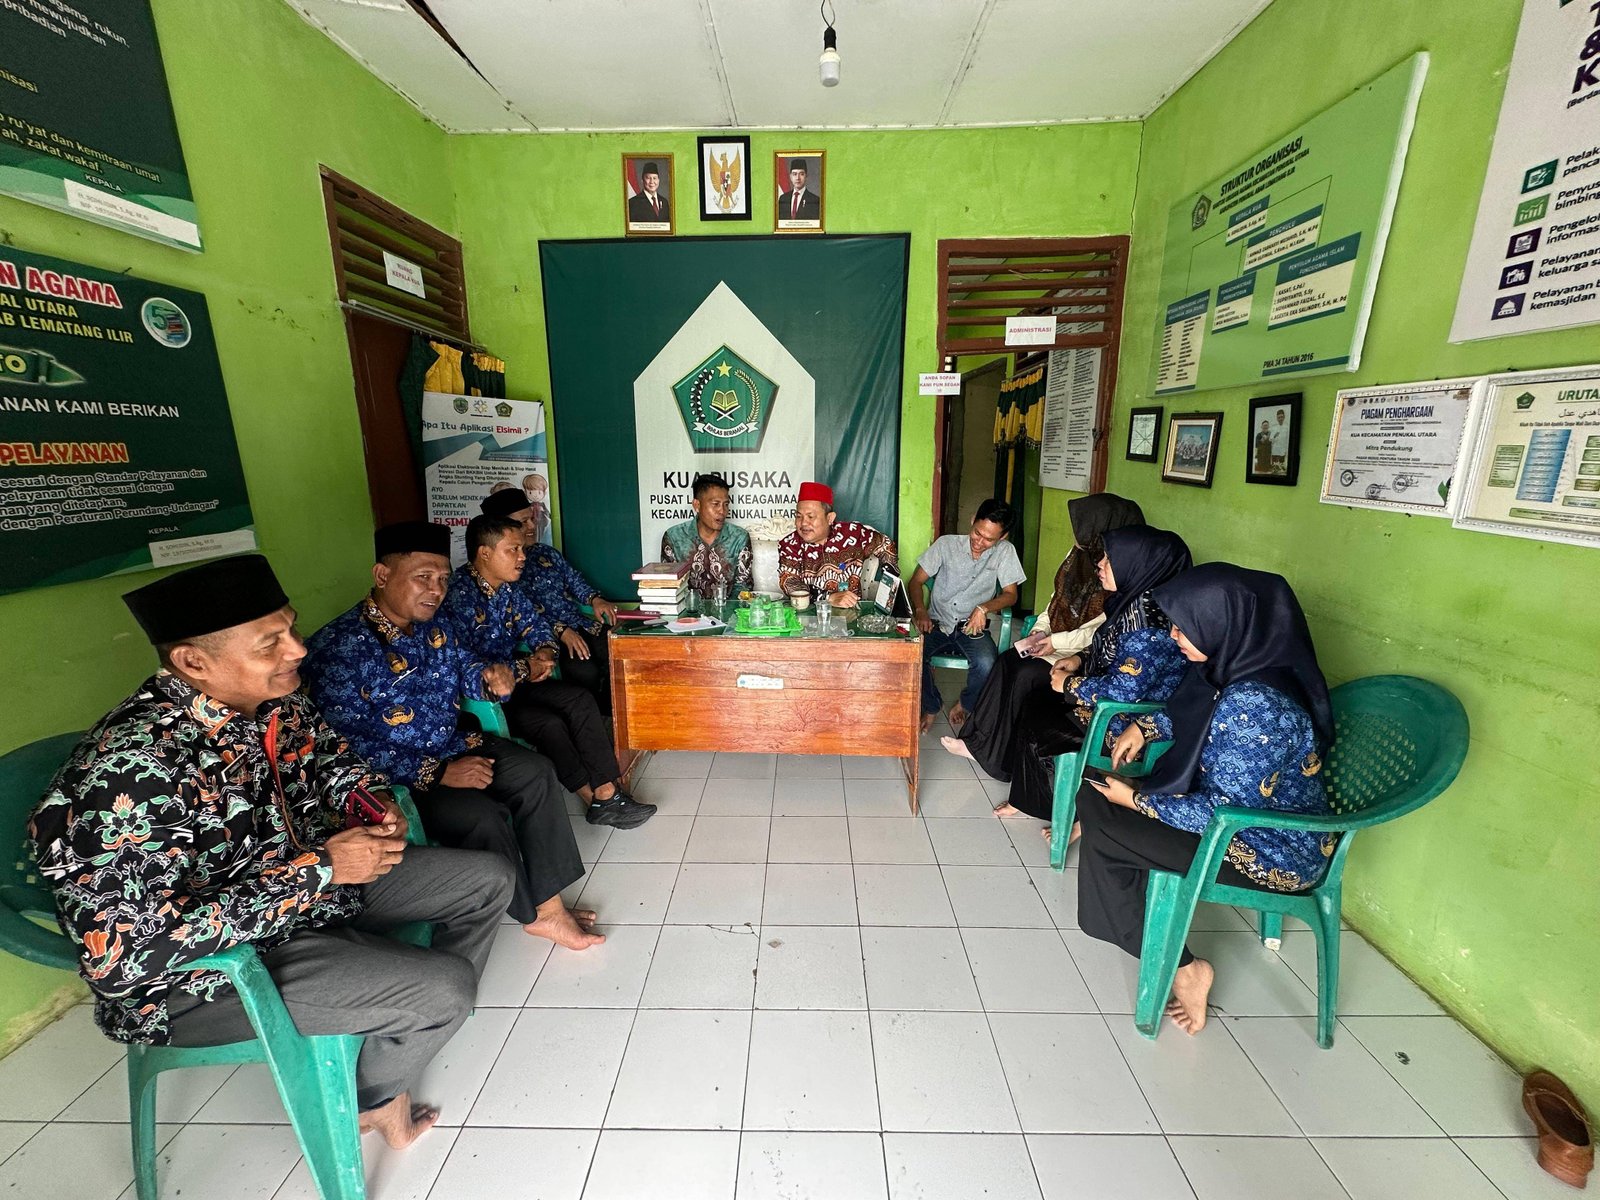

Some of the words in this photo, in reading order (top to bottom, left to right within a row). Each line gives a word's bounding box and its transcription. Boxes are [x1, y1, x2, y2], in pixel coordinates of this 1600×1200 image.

[0, 0, 66, 37] pribadian
[27, 137, 61, 158] zakat
[50, 132, 75, 149] dan
[77, 142, 133, 172] kemitraan
[134, 165, 162, 183] umat
[1220, 166, 1255, 197] STRUKTUR
[1255, 135, 1303, 175] ORGANISASI
[1329, 245, 1346, 256] ISLAM
[1538, 261, 1589, 278] keluarga
[26, 266, 123, 309] AGAMA
[1533, 282, 1593, 300] Pelayanan
[25, 297, 78, 318] UTARA
[1530, 293, 1596, 310] kemasjidan
[0, 312, 15, 326] B
[20, 314, 102, 339] LEMATANG
[107, 330, 134, 343] ILIR
[1281, 355, 1300, 365] TAHUN
[1299, 352, 1315, 362] 2016
[1557, 388, 1600, 401] URUTA
[55, 399, 104, 415] KAMI
[108, 402, 180, 418] BERIKAN
[1361, 408, 1385, 420] PIAGAM
[1384, 405, 1434, 419] PENGHARGAAN
[441, 421, 457, 430] Itu
[460, 423, 494, 433] Aplikasi
[0, 442, 129, 466] PELAYANAN
[0, 474, 46, 488] sesuai
[48, 474, 94, 486] dengan
[95, 472, 138, 483] Standar
[140, 470, 189, 481] Pelayanan
[190, 469, 207, 477] dan
[0, 490, 67, 504] pelayanan
[67, 486, 99, 497] tidak
[100, 483, 136, 495] sesuai
[137, 482, 174, 493] dengan
[650, 494, 684, 505] PUSAT
[737, 494, 797, 504] KEAGAMAA
[27, 503, 61, 516] yang
[62, 498, 127, 511] ditetapkan,
[651, 509, 695, 519] KECAMA
[726, 509, 767, 519] ENUKAL
[770, 509, 797, 519] UTAR
[1, 517, 53, 530] dengan
[54, 511, 112, 525] Peraturan
[433, 517, 470, 526] ELSIMI
